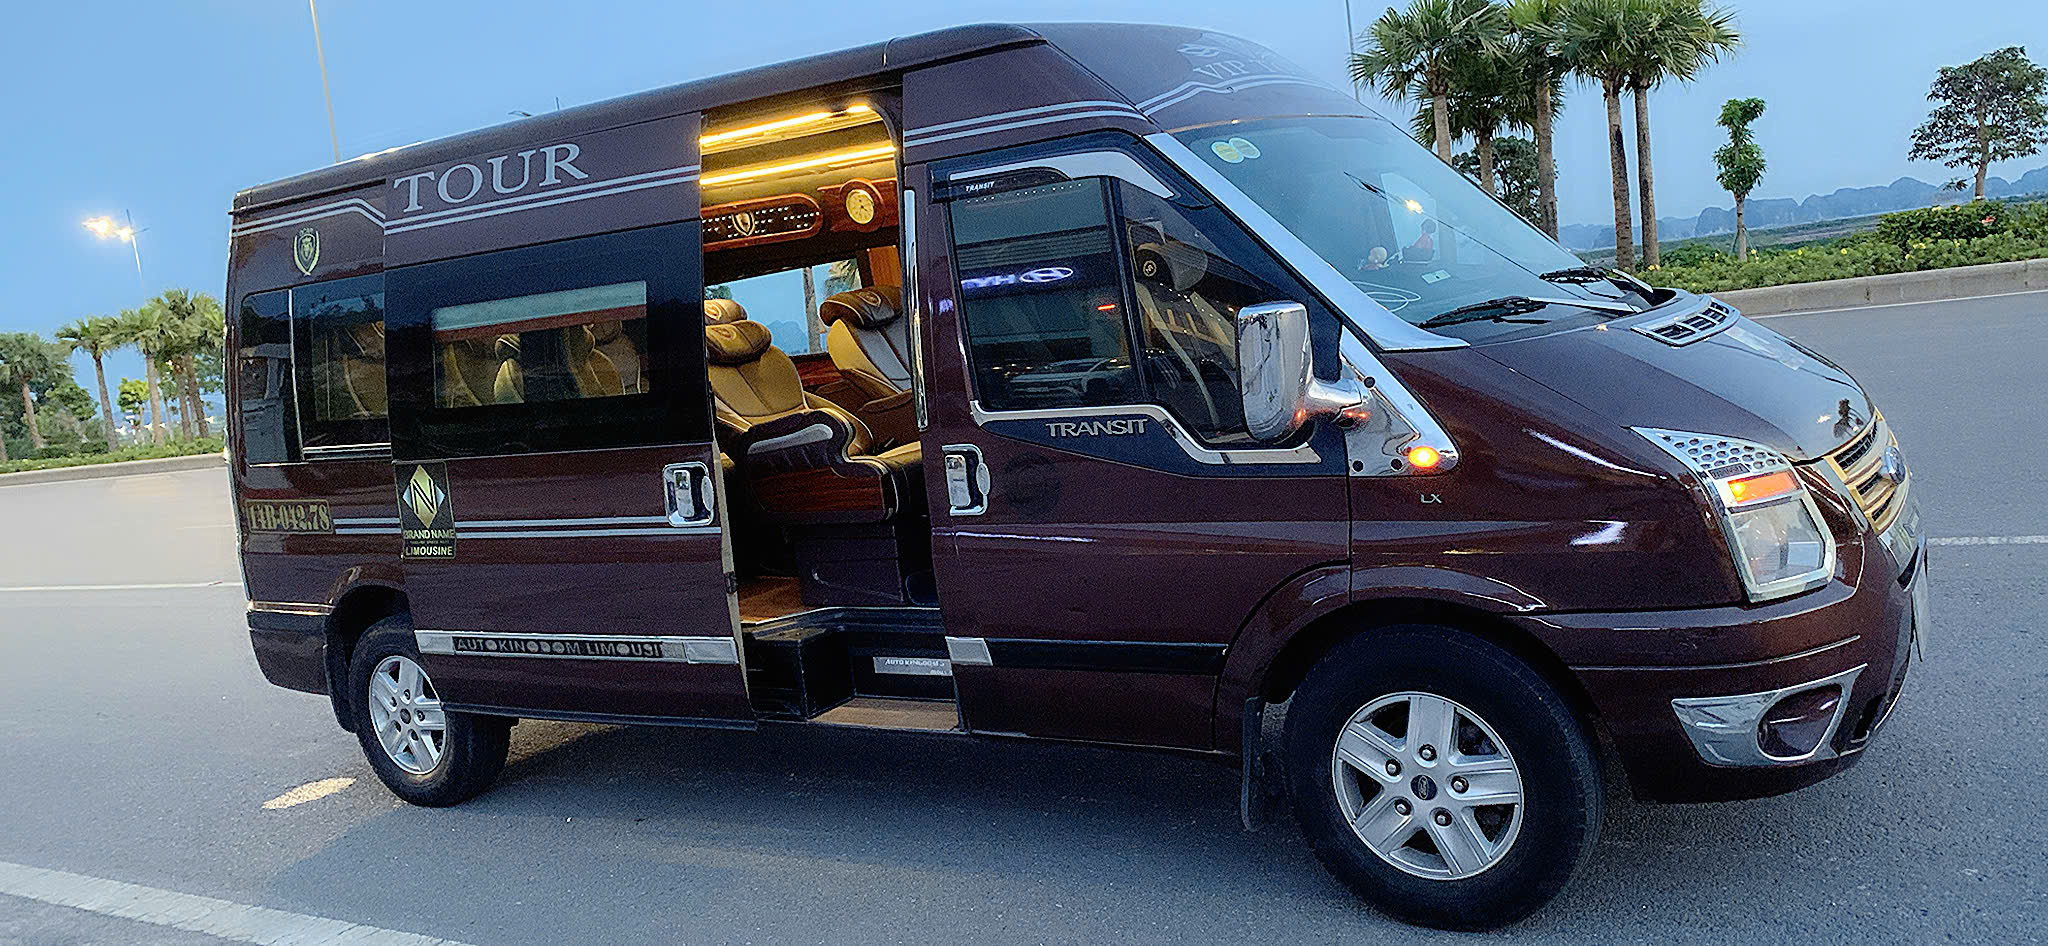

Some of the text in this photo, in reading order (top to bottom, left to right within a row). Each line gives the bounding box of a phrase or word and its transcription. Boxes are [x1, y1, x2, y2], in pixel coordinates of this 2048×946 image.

[1193, 60, 1249, 79] VIP
[393, 143, 589, 213] TOUR
[966, 181, 995, 192] TRANSIT
[1046, 419, 1148, 437] TRANSIT
[1421, 494, 1442, 504] LX
[403, 529, 455, 539] BRAND NAME
[405, 545, 453, 556] LIMOUSINE
